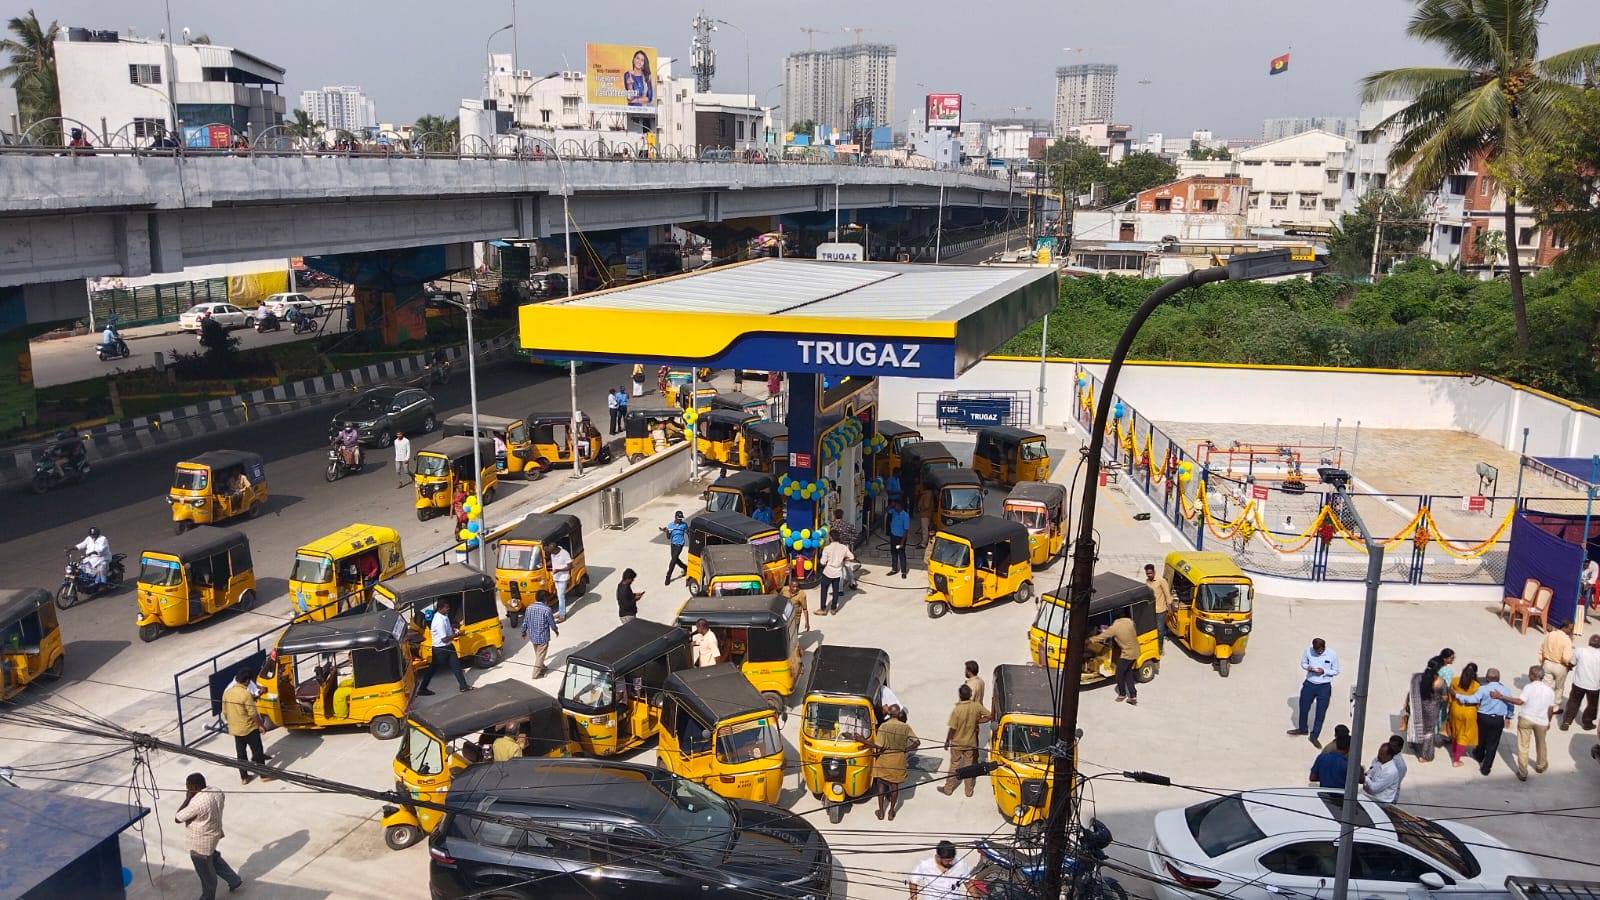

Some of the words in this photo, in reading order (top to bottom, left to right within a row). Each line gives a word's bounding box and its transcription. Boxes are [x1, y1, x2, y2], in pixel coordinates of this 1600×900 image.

[821, 252, 857, 261] TRUGAZ
[797, 340, 921, 368] TRUGAZ
[970, 413, 998, 421] TRUGAZ
